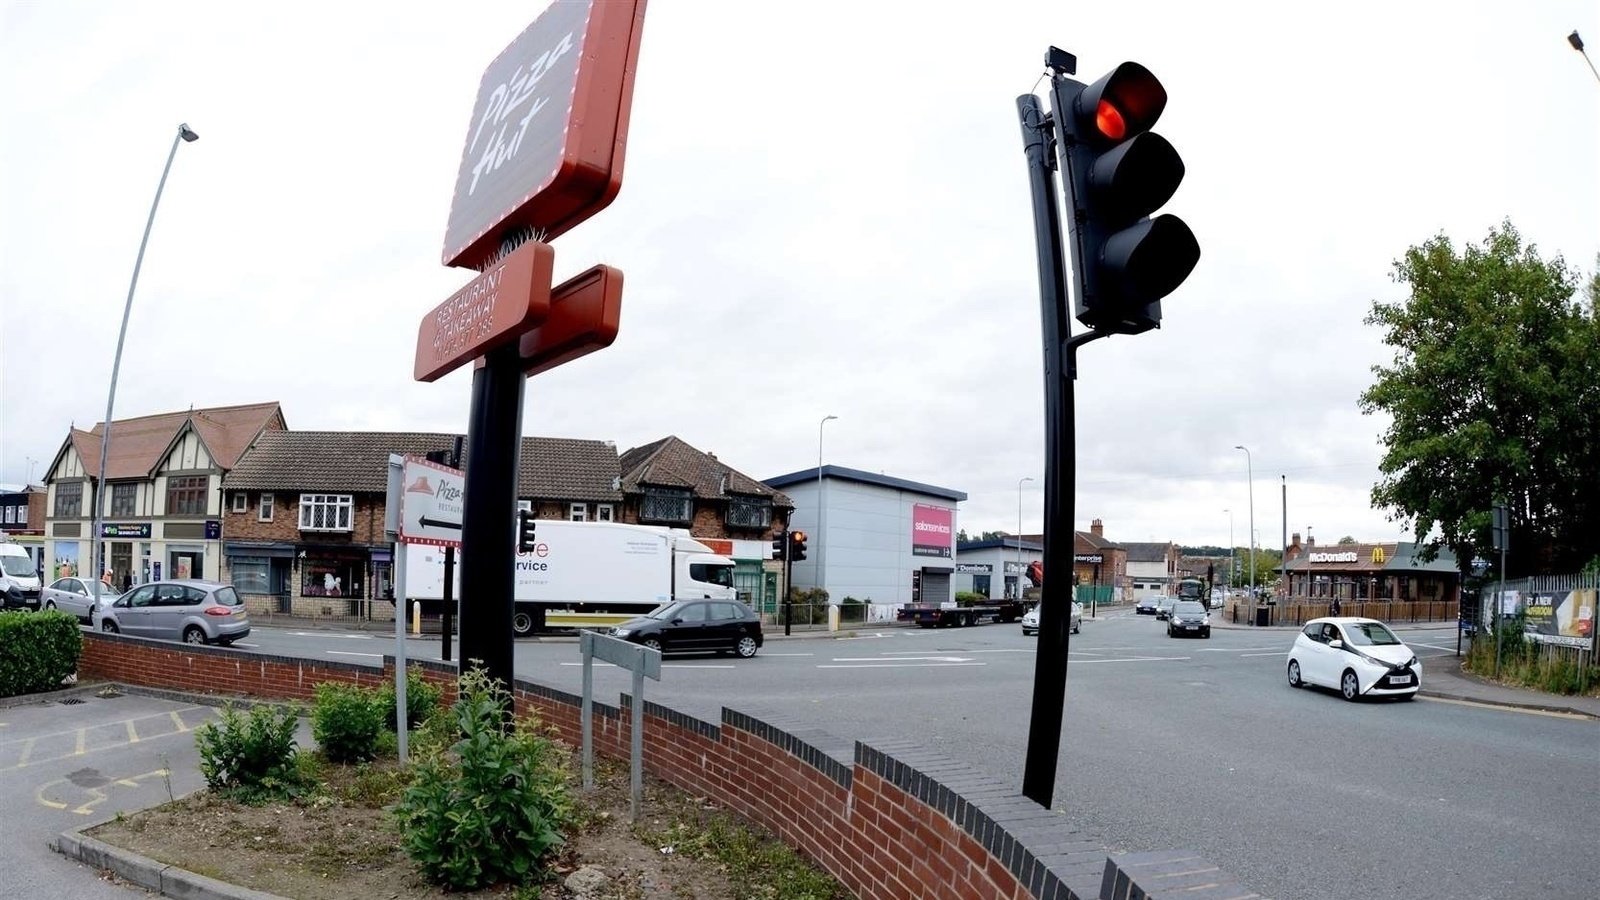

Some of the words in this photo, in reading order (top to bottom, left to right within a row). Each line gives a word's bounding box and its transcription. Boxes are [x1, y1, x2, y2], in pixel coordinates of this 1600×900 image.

[469, 32, 573, 155] Pizza
[468, 96, 550, 196] Hut
[437, 264, 506, 327] RESTAURANT
[443, 291, 499, 342] TAKEAWAY
[436, 479, 460, 501] Pizza
[438, 502, 463, 513] RESTAUR
[516, 559, 548, 572] rvice
[1074, 554, 1103, 563] nterprise
[1309, 552, 1357, 563] McDonald's
